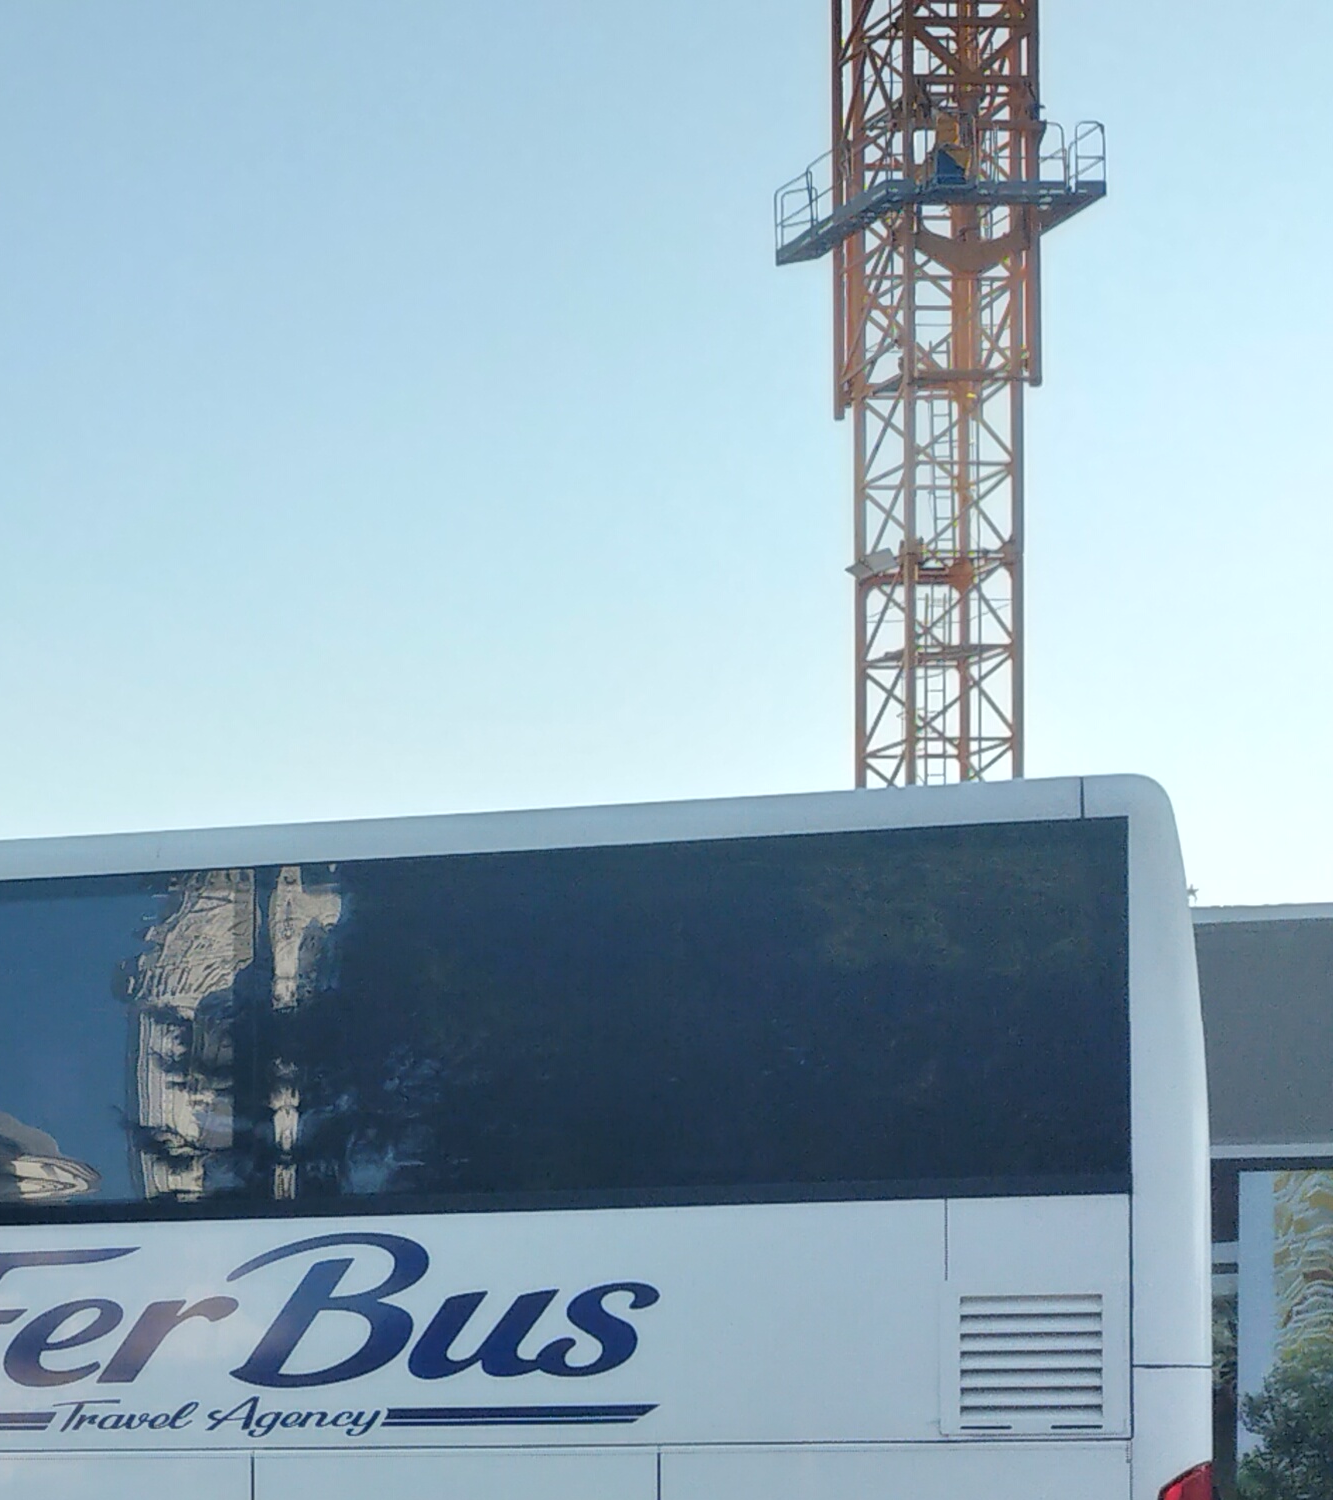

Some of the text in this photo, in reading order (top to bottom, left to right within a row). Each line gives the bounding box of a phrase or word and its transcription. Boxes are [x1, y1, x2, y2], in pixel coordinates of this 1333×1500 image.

[226, 1232, 661, 1389] Bus
[52, 1395, 382, 1438] Travel Agency
